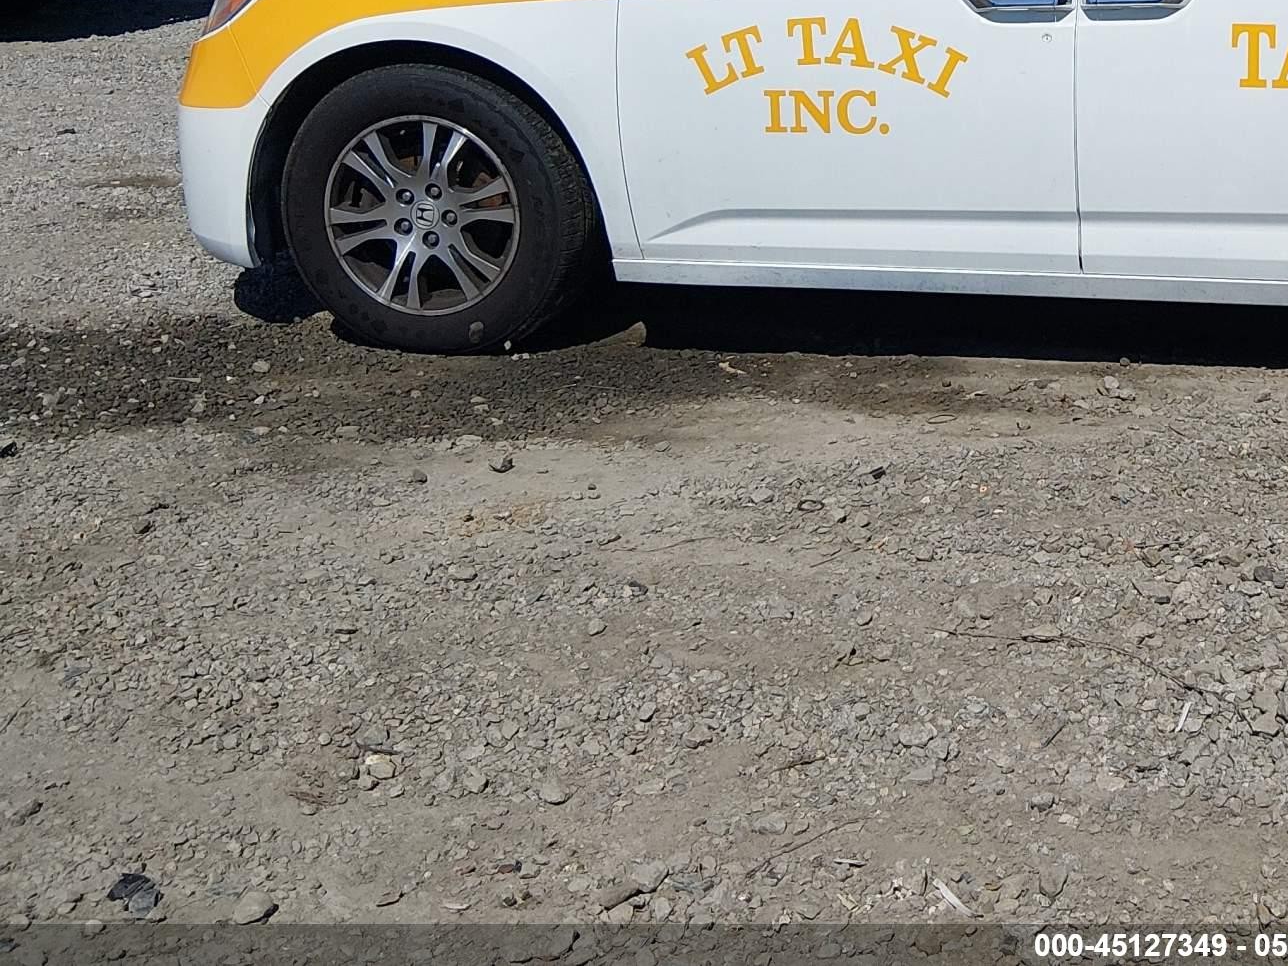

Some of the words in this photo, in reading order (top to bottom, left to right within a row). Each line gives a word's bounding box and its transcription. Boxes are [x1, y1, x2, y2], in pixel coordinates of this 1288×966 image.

[685, 25, 764, 95] LT
[787, 16, 968, 98] TAXI
[763, 89, 890, 135] INC.
